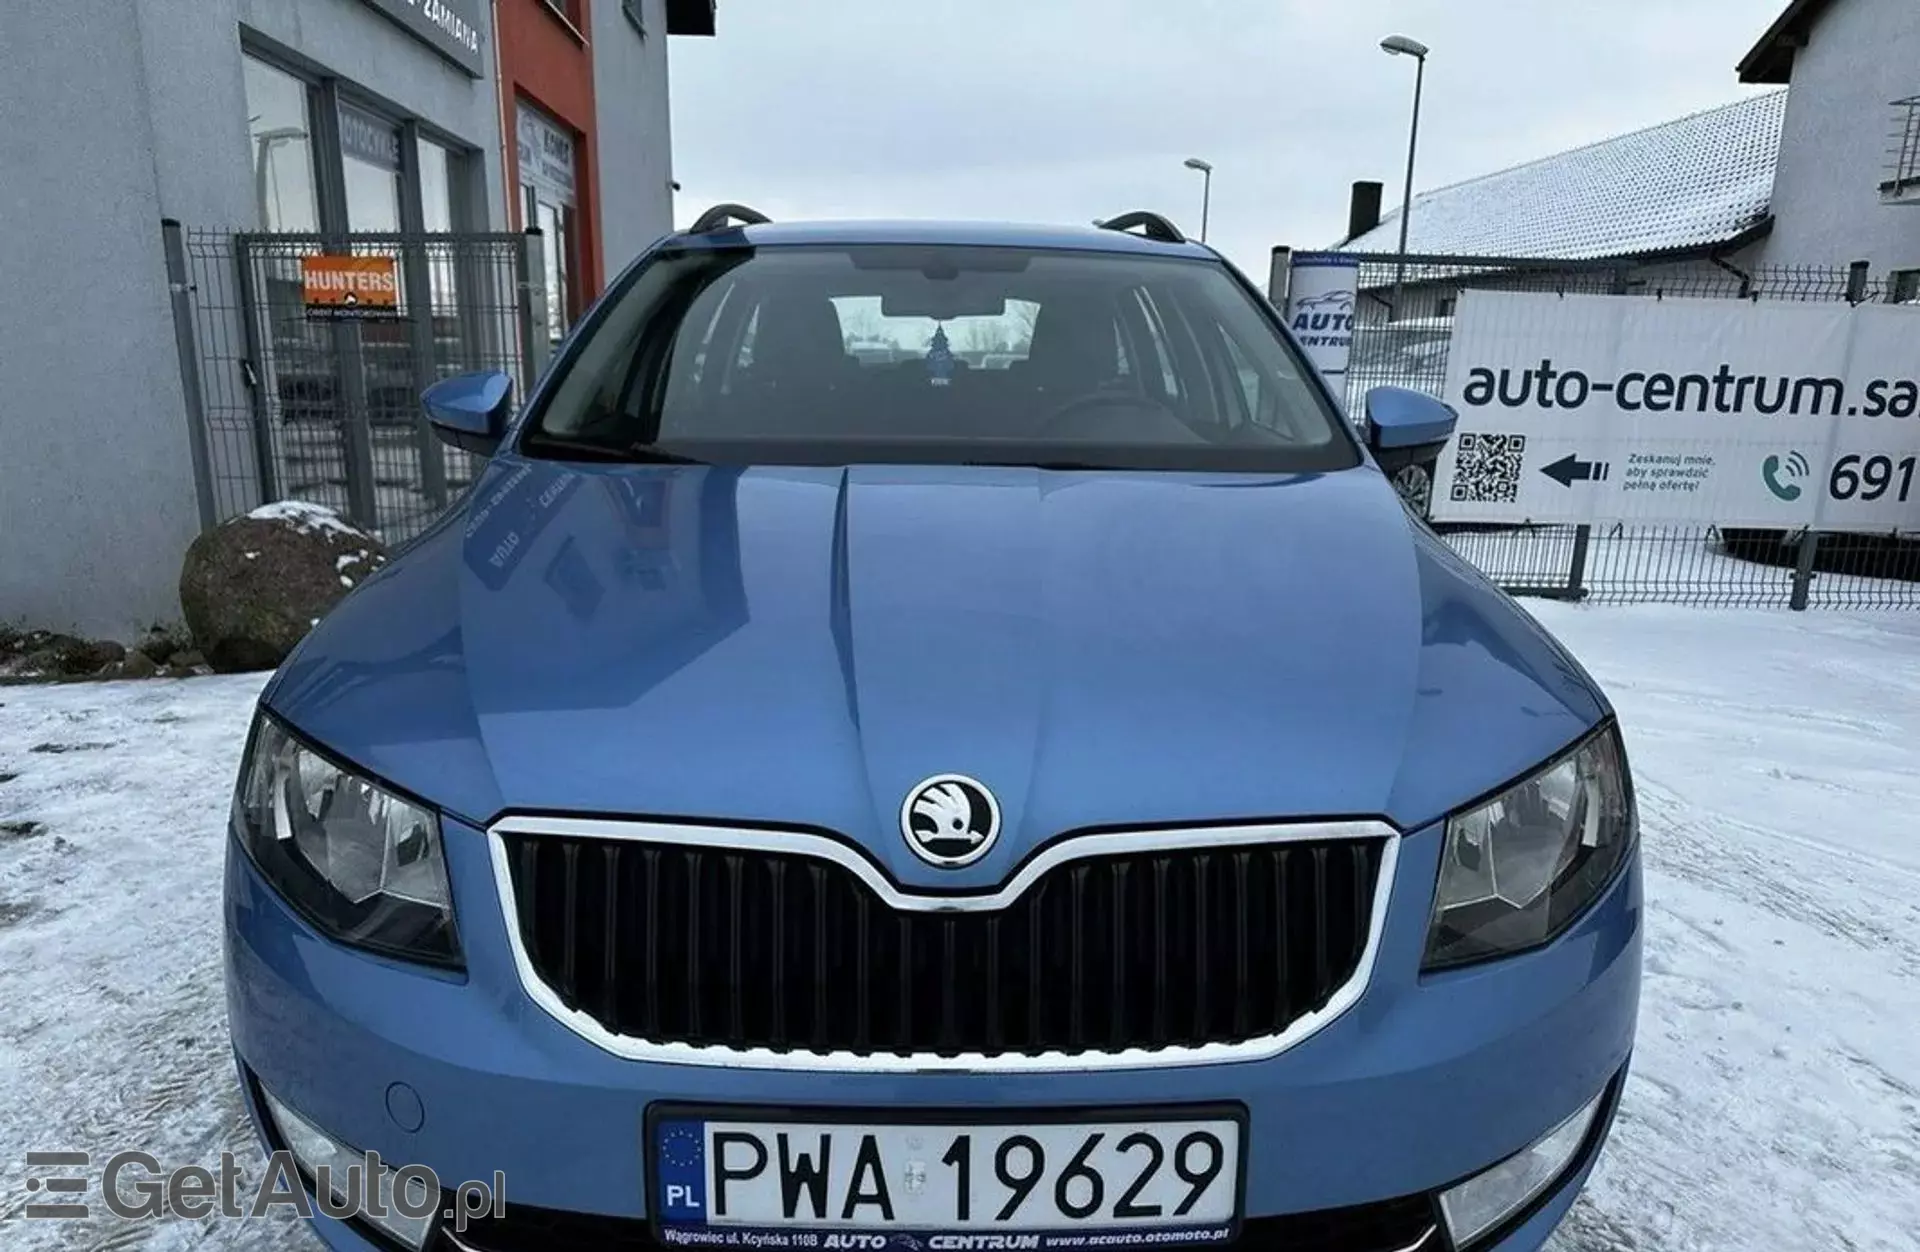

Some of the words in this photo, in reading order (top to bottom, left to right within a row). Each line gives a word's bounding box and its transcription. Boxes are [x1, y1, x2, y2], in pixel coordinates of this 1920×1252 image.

[424, 0, 478, 53] ZAMIANA
[305, 271, 394, 291] HUNTERS
[1463, 359, 1920, 418] auto-centrum.sa
[1628, 453, 1681, 466] Zeskanuj
[1626, 467, 1648, 479] aby
[1650, 465, 1709, 479] sprawdzić
[1829, 454, 1917, 502] 691
[1623, 480, 1656, 492] pełną
[713, 1131, 896, 1221] PWA
[941, 1130, 1224, 1221] 19629
[666, 1186, 701, 1208] PL
[664, 1228, 724, 1245] Wągrowiec
[726, 1231, 740, 1245] ul.
[742, 1231, 789, 1248] Kcyńska
[824, 1235, 886, 1249] AUTO
[928, 1235, 1040, 1250] CENTRUM
[1045, 1228, 1229, 1248] www.acauto.otomoto.pl
